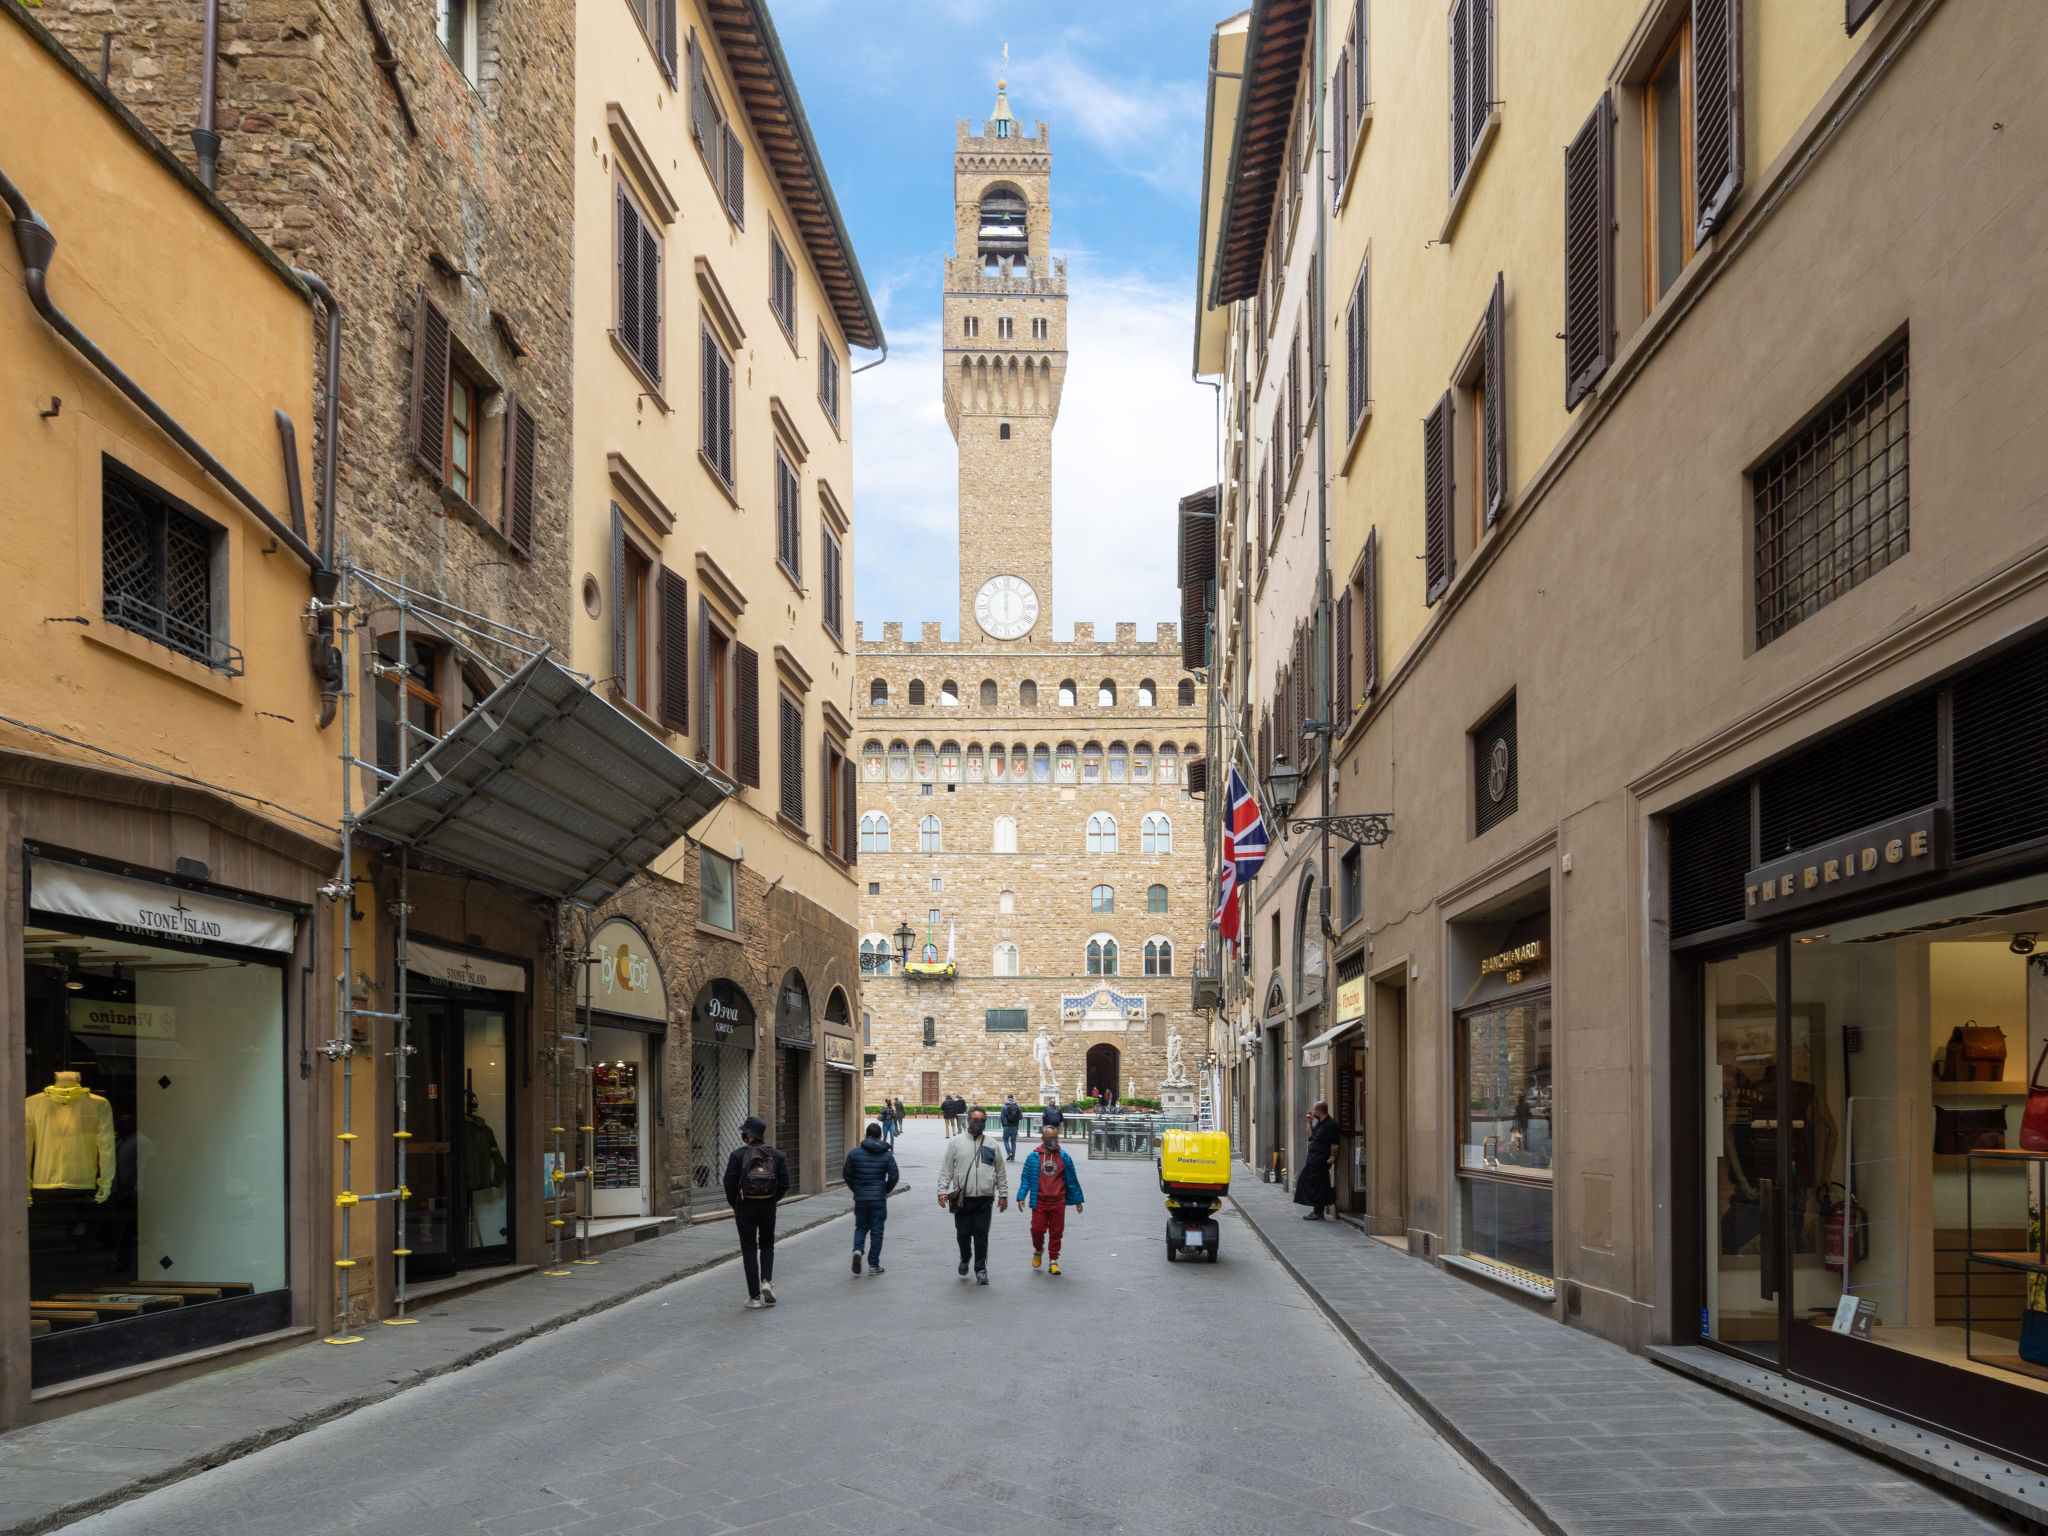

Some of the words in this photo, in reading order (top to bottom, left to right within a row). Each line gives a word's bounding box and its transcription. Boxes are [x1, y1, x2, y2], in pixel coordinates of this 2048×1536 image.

[1746, 874, 1794, 905] THE
[1804, 830, 1928, 889] BRIDGE
[139, 909, 178, 930] STONE
[184, 917, 221, 937] ISLAND
[1481, 950, 1512, 974] BIANCHI
[1515, 940, 1541, 963] NARDI
[446, 968, 466, 982] STONE
[468, 972, 487, 986] ISLAND
[709, 998, 739, 1021] Diva
